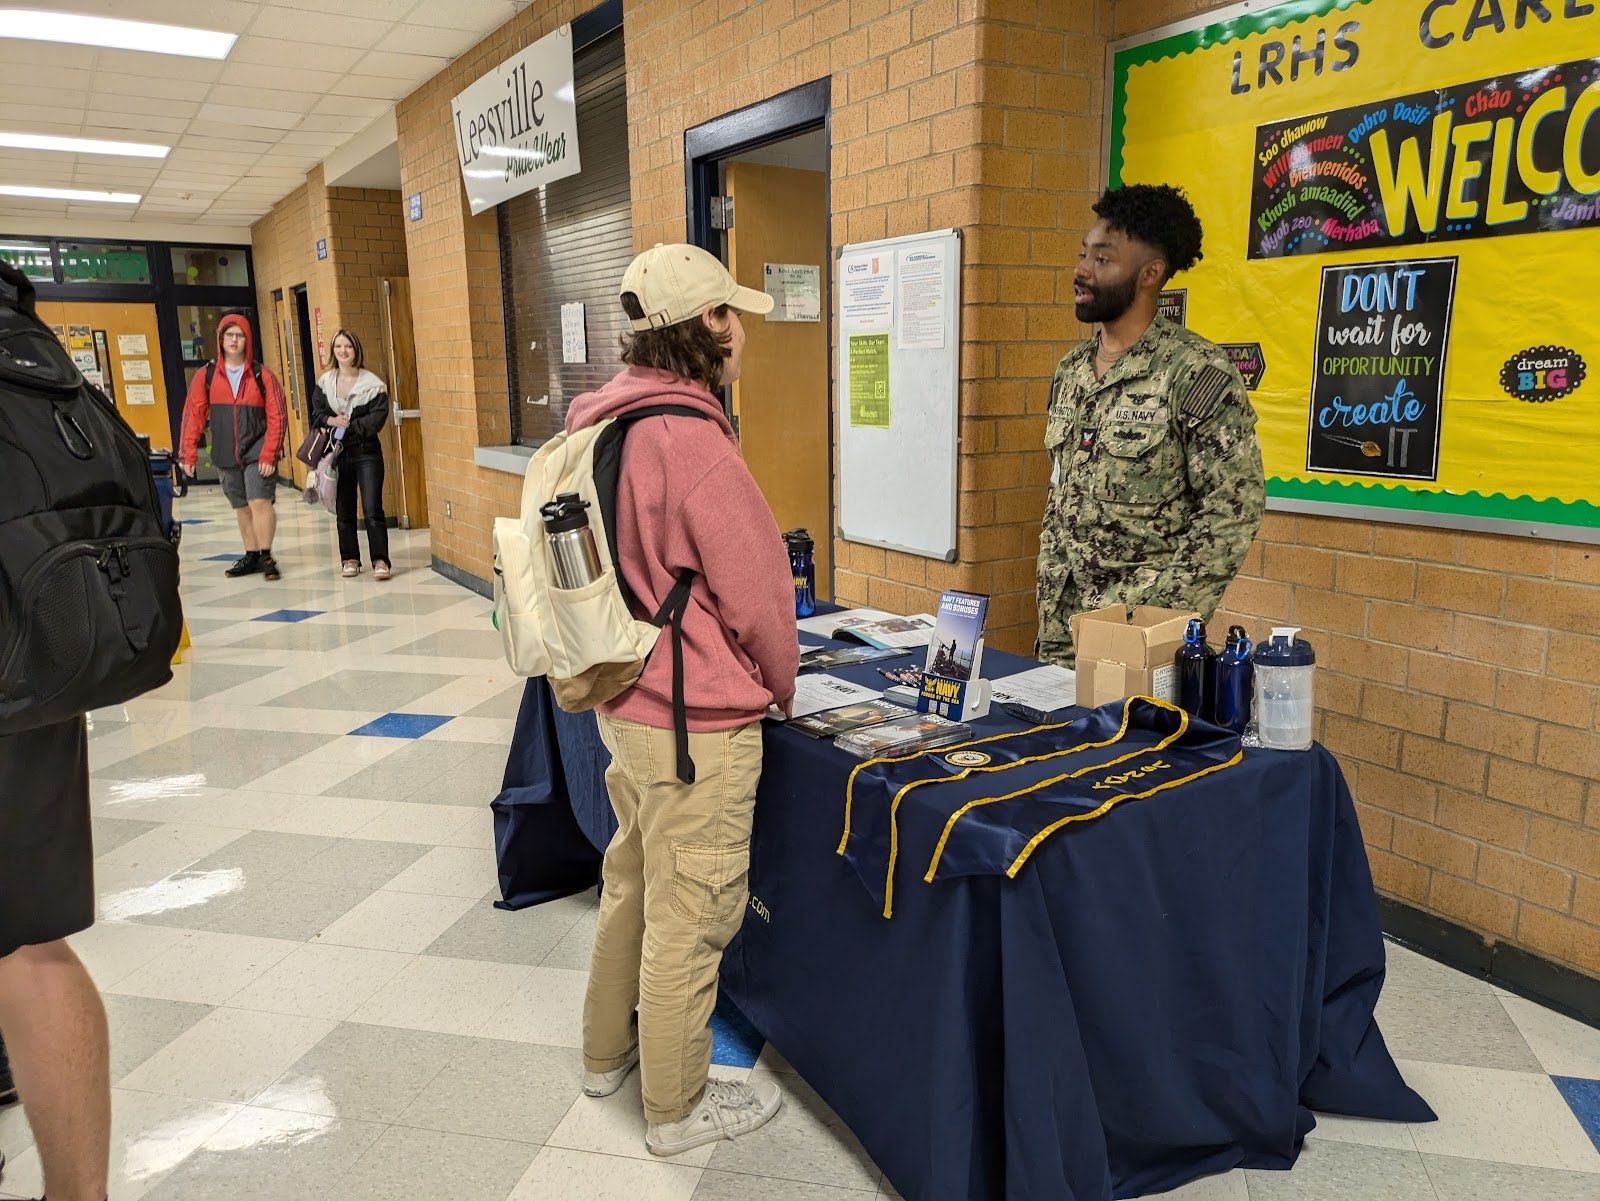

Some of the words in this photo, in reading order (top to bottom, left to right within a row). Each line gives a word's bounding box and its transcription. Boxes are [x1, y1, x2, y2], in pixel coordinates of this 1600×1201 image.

[1230, 20, 1361, 95] LRHS
[456, 61, 545, 167] Leesville
[1347, 107, 1388, 144] Dobro
[1258, 144, 1279, 167] Soo
[1280, 116, 1329, 149] dhawow
[1368, 79, 1600, 237] WELCO
[1257, 189, 1297, 232] Khush
[1260, 217, 1290, 254] Nyob
[1320, 217, 1380, 242] Merhaba
[1341, 269, 1425, 314] DON'T
[1327, 316, 1385, 346] wait
[1384, 313, 1431, 356] for
[1322, 355, 1436, 377] OPPORTUNITY
[1516, 356, 1570, 373] dream
[1517, 368, 1568, 392] BIG
[1116, 410, 1130, 420] U.S.
[1132, 411, 1157, 422] NAVY
[1318, 379, 1428, 430] create
[1387, 427, 1419, 468] IT
[793, 576, 808, 586] AVY
[941, 602, 953, 611] AND
[952, 604, 979, 615] BONUSES
[942, 594, 956, 603] NAVY
[955, 596, 981, 608] FEATURES
[935, 681, 961, 698] NAVY
